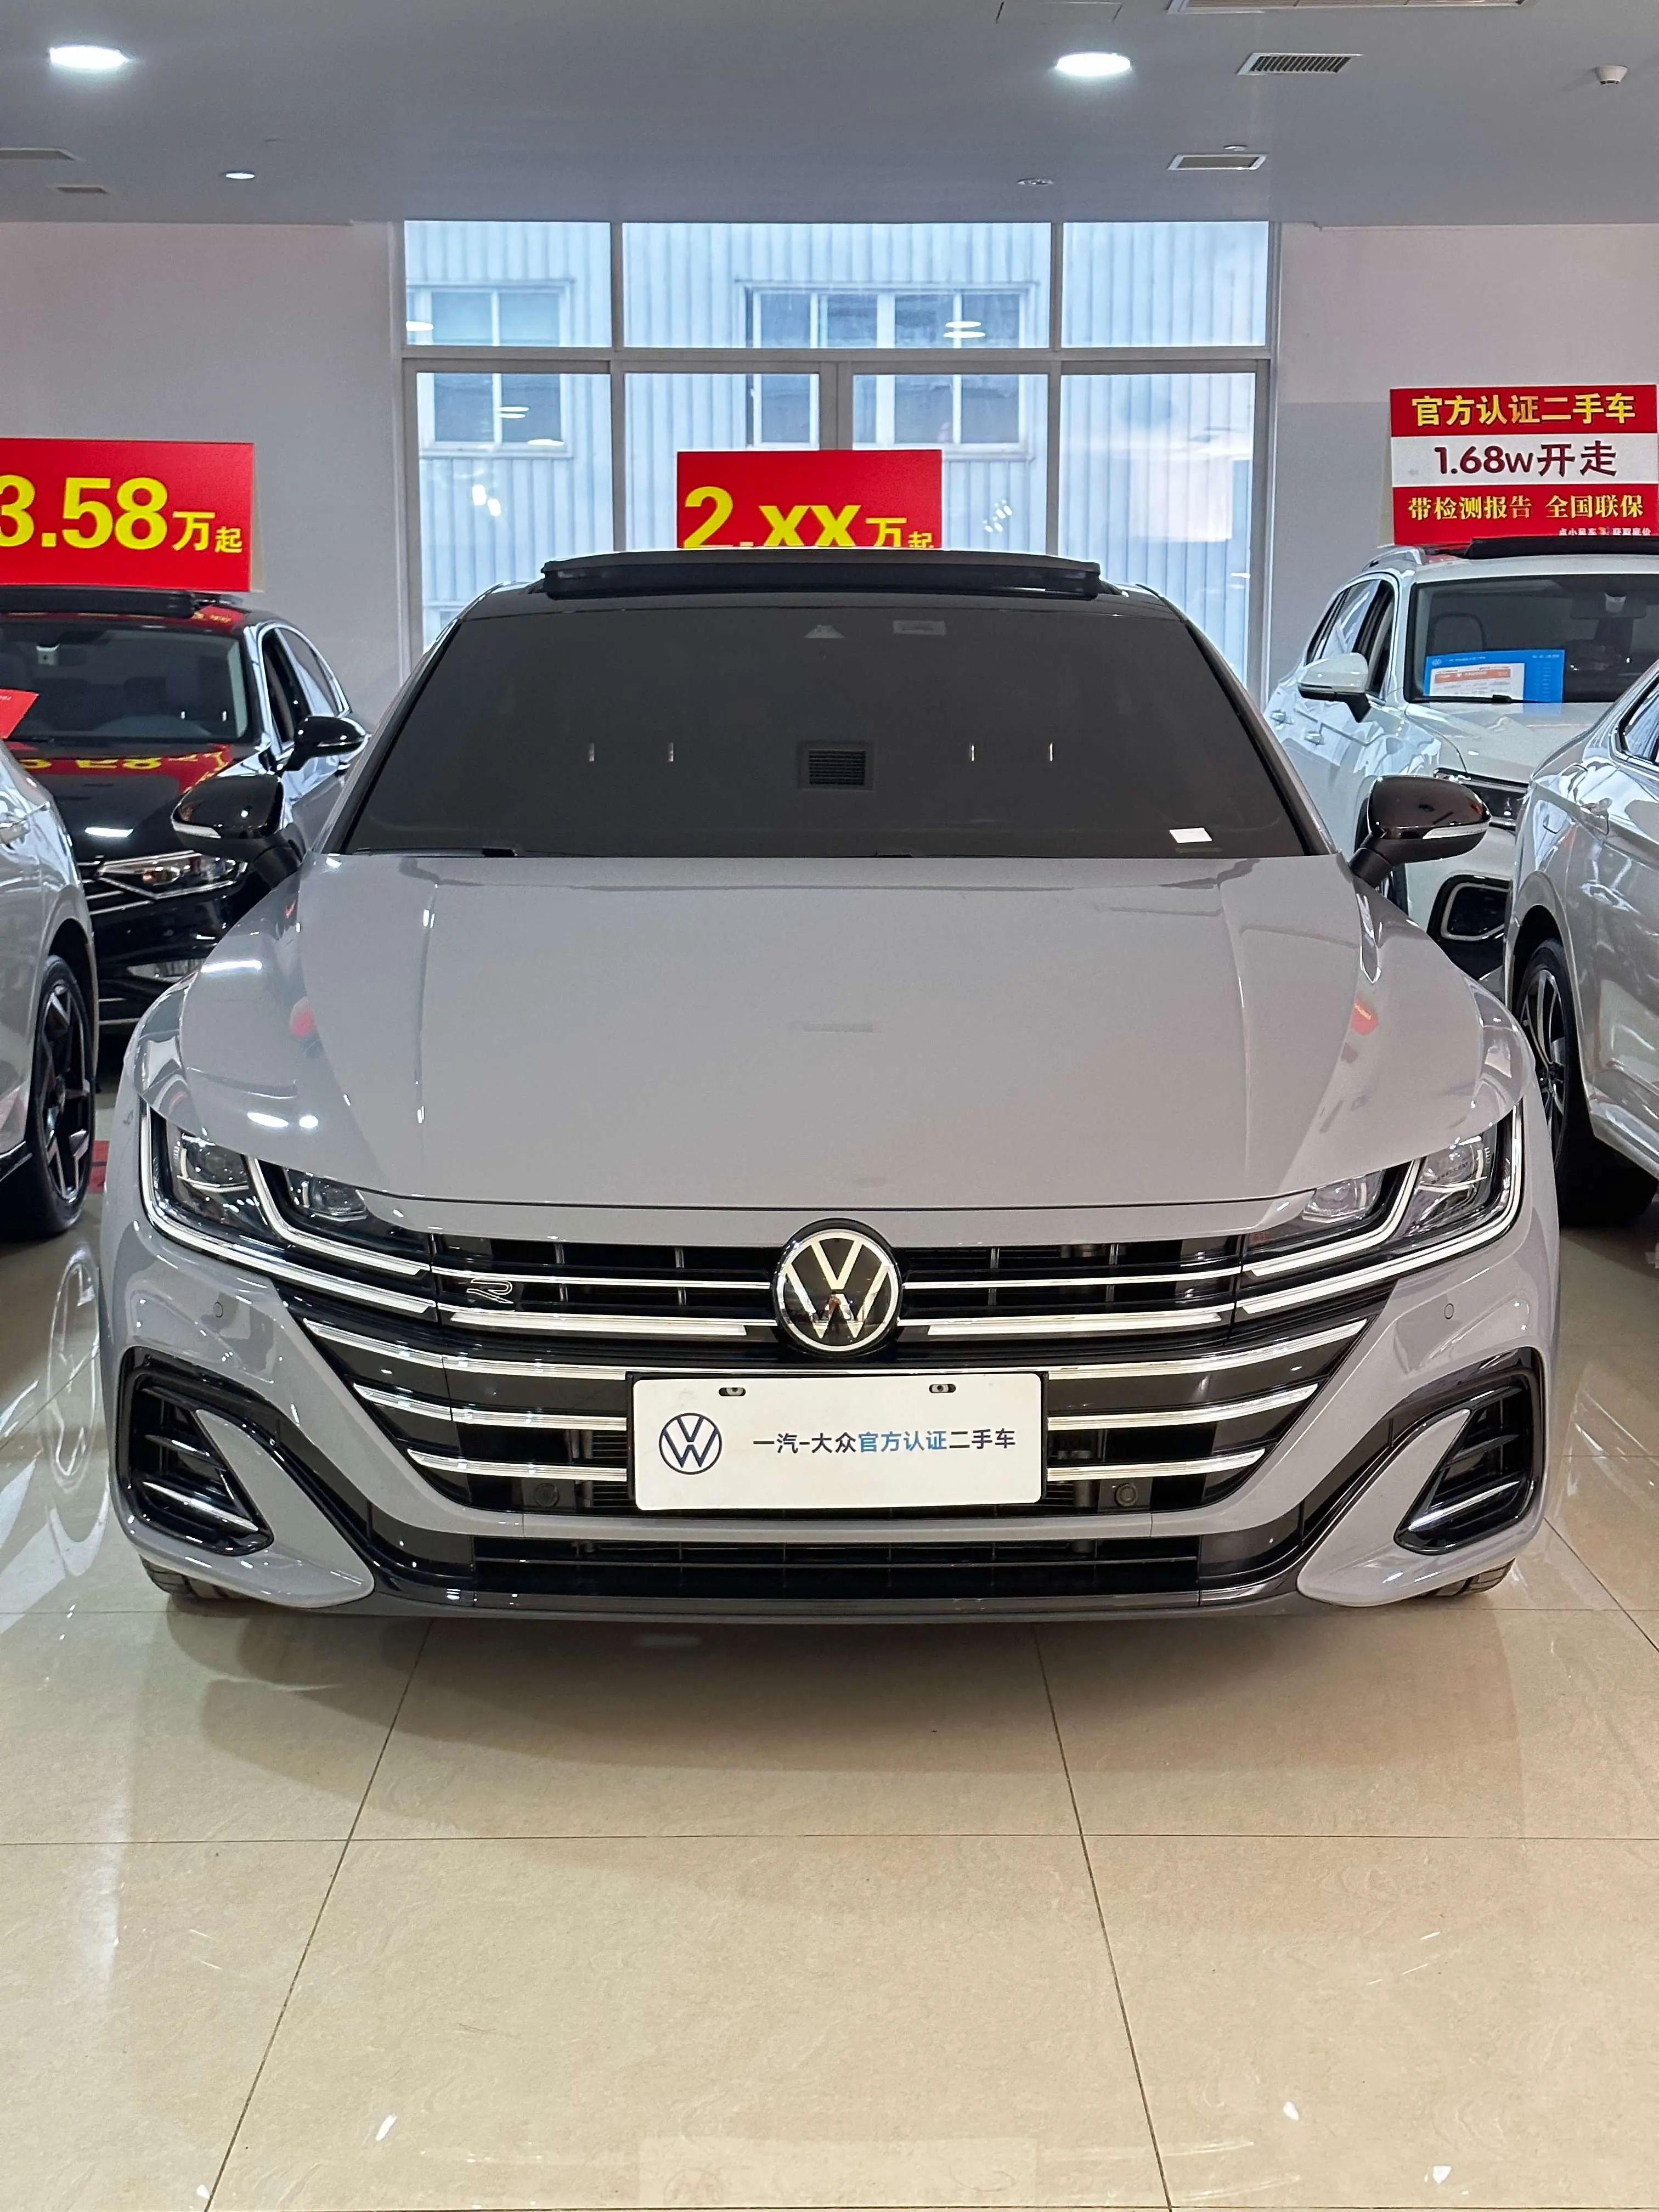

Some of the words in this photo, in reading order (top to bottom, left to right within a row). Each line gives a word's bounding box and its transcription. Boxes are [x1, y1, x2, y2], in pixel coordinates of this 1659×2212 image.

[1412, 393, 1635, 426] 官方认证二手车
[1408, 496, 1532, 521] 带检测报告
[1545, 495, 1644, 518] 全国联保
[754, 1430, 1016, 1453] 一汽-大众官方认证二手车
